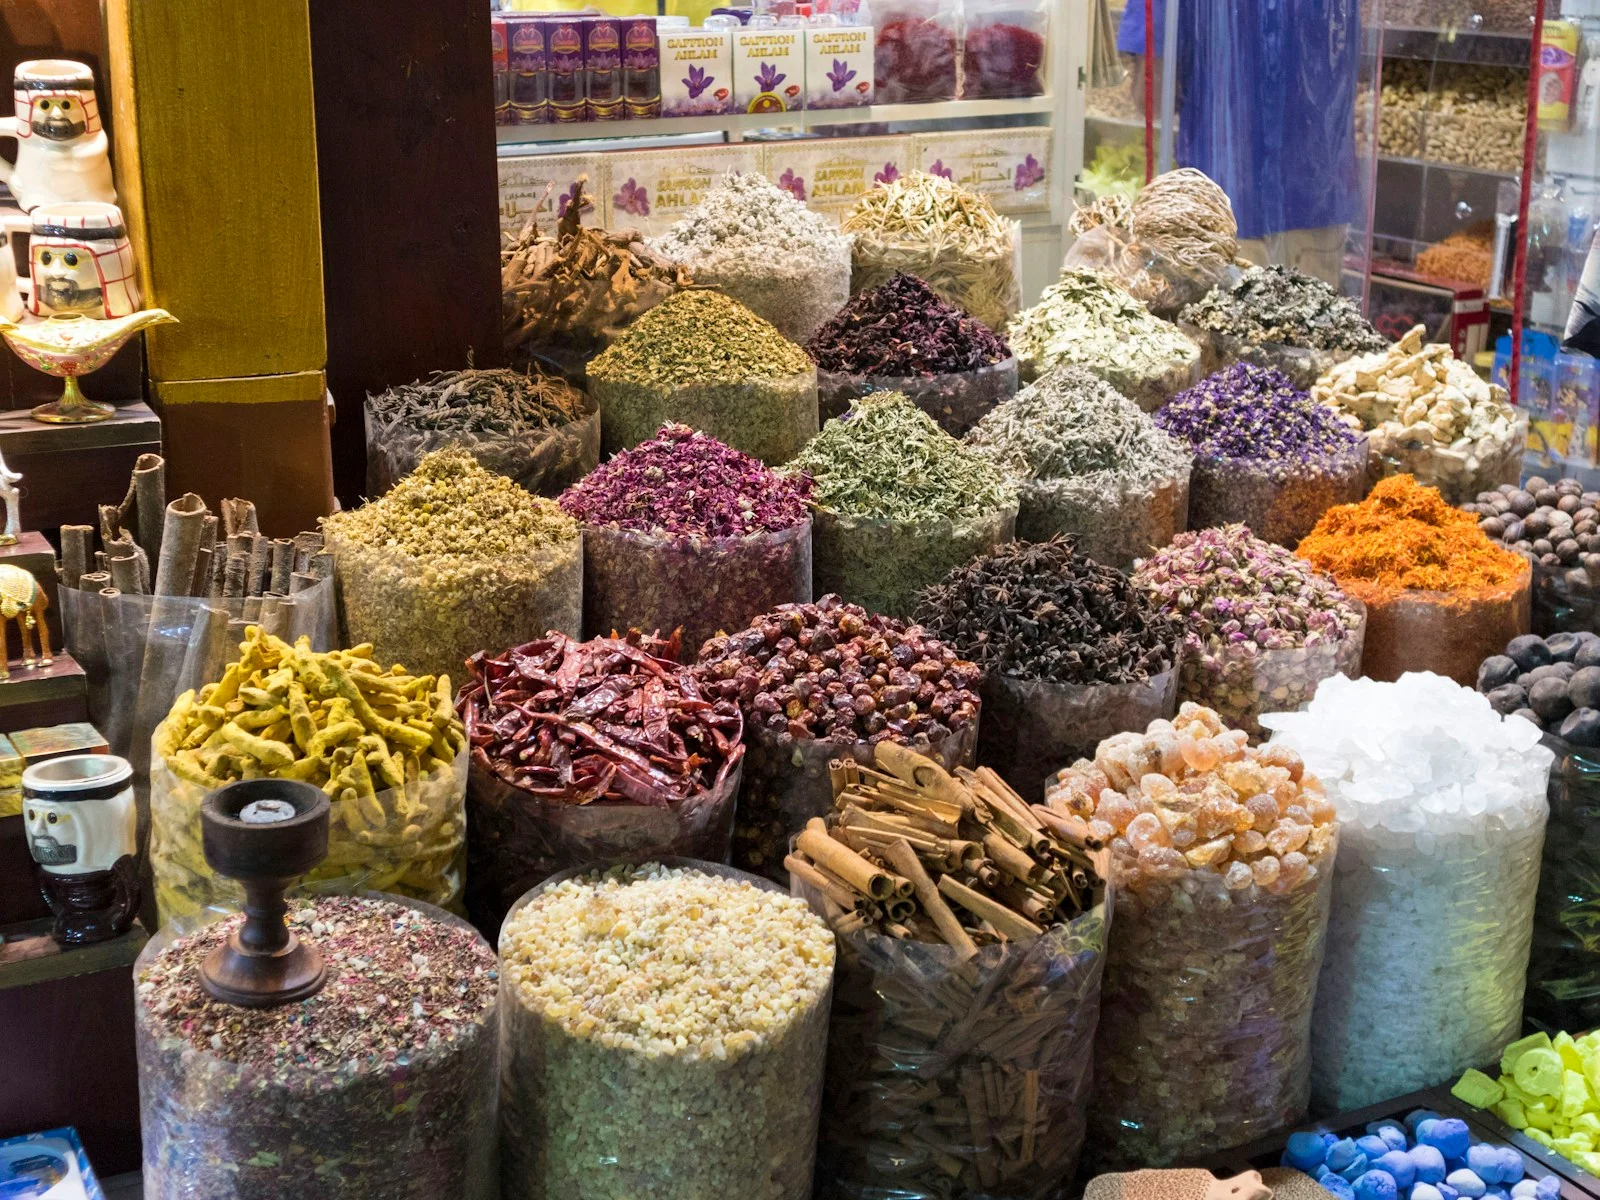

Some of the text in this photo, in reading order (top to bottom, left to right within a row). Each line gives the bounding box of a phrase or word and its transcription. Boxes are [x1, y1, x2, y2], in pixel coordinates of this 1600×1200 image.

[667, 37, 723, 48] SAFFRON
[740, 35, 795, 46] SAFFRON
[813, 32, 866, 43] SAFFRON
[674, 49, 717, 60] AHLAM
[747, 47, 789, 57] AHLAM
[820, 44, 860, 54] AHLAM
[814, 167, 864, 181] SAFFRON
[656, 177, 711, 192] SAFFRON
[812, 181, 865, 197] AHLAM
[655, 191, 705, 208] AHLA
